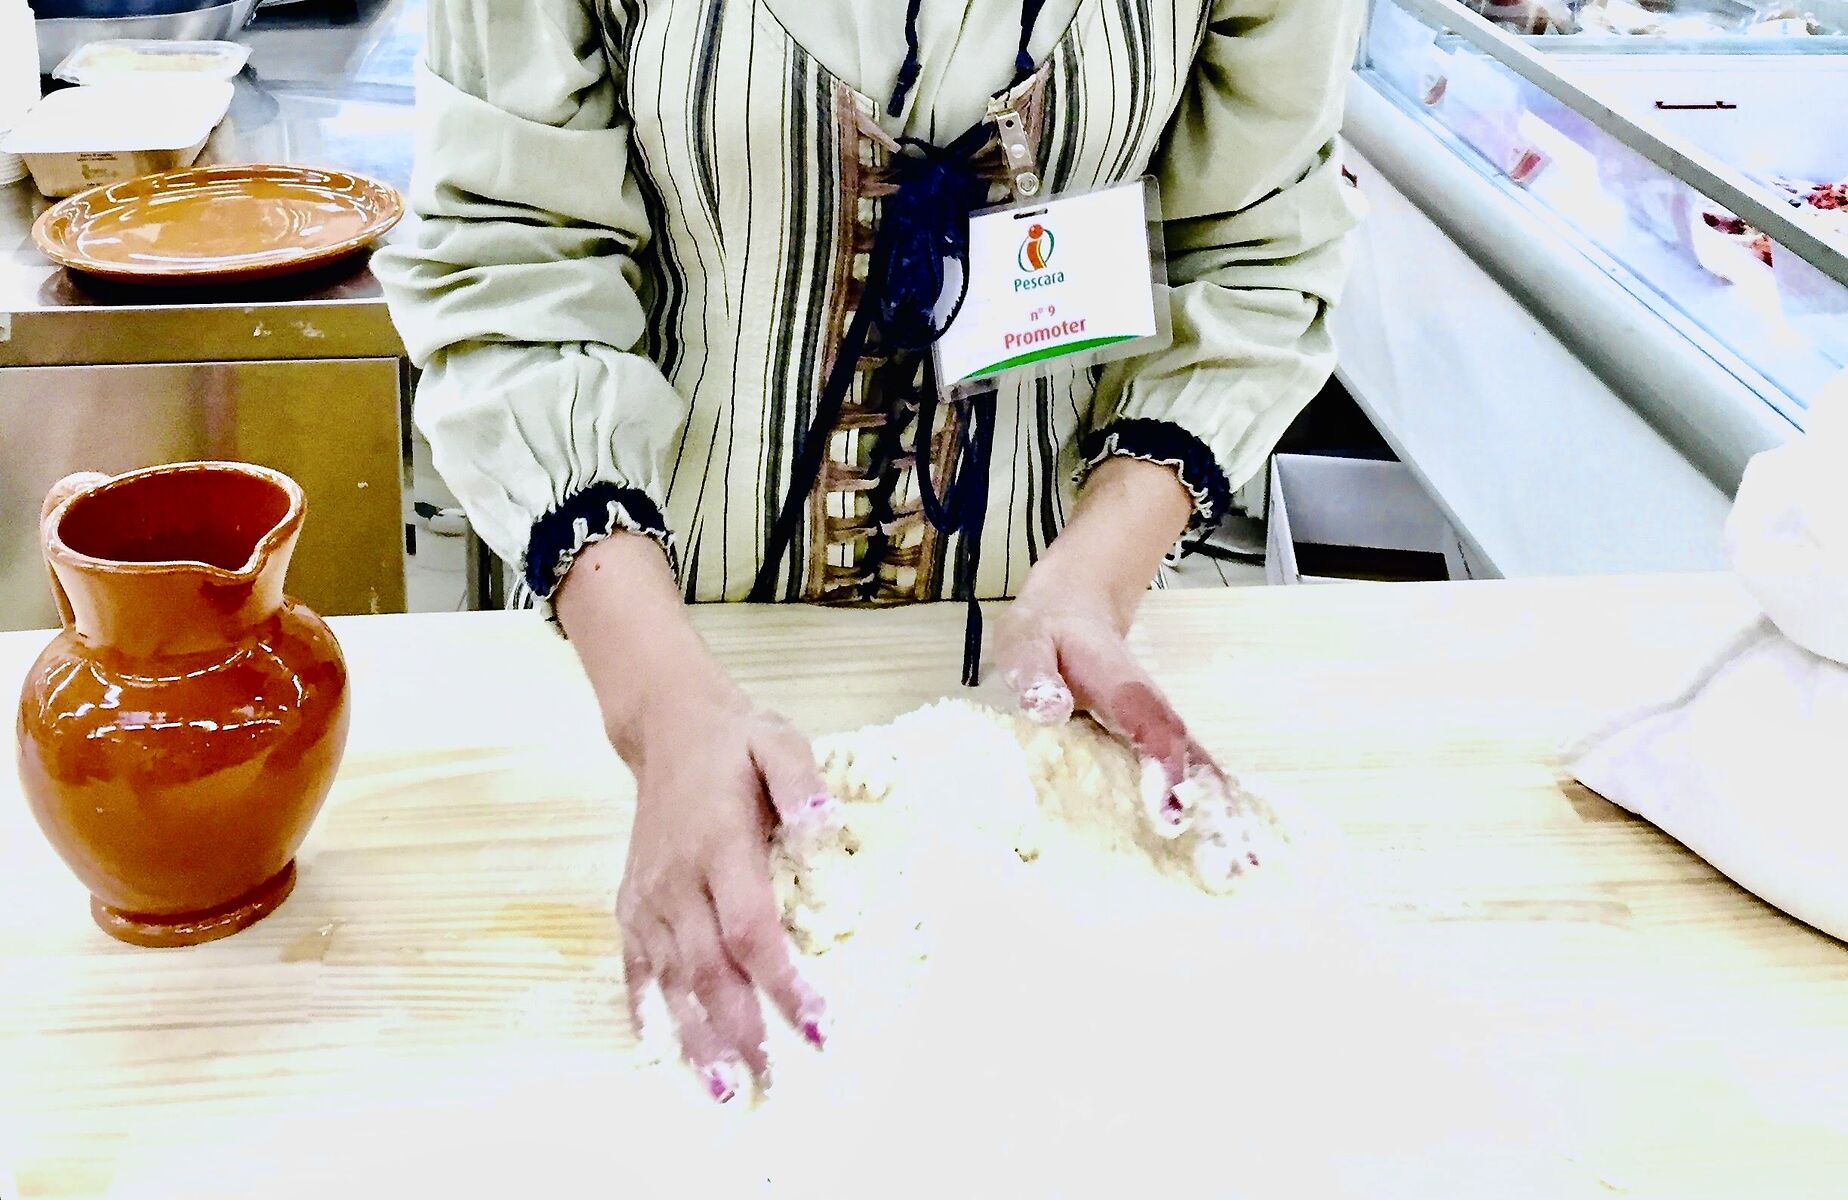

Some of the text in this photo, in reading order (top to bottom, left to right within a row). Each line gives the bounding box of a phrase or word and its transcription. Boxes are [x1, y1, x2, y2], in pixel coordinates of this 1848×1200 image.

[1014, 271, 1065, 292] Pescara
[1048, 304, 1056, 317] 9
[1004, 318, 1087, 349] Promoter
